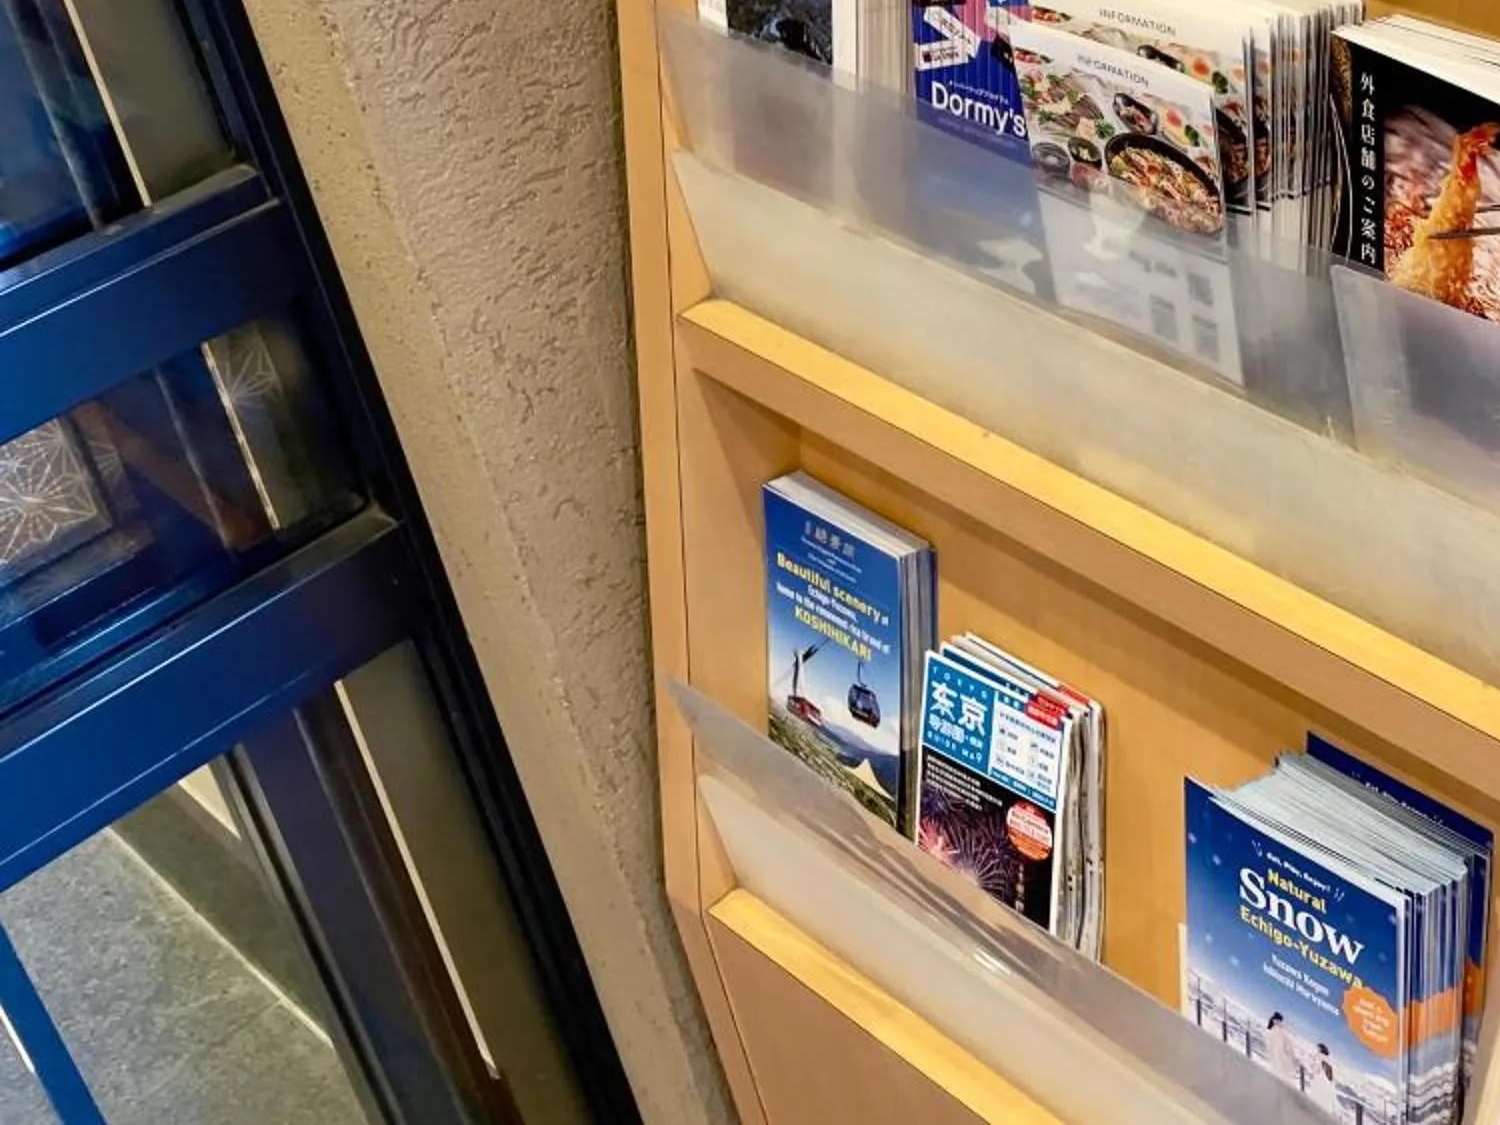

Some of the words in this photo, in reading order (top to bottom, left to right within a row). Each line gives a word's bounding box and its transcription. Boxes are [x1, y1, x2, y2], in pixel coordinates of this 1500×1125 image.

[1099, 8, 1177, 37] INFORMATION
[931, 79, 1026, 138] Dormy's
[776, 550, 831, 594] Beautiful
[832, 585, 881, 625] scenery
[794, 604, 872, 661] KOSHIHIKARI
[1239, 867, 1366, 965] Snow
[1266, 868, 1327, 914] Natural
[1239, 904, 1363, 988] Echigo-Yuzawa
